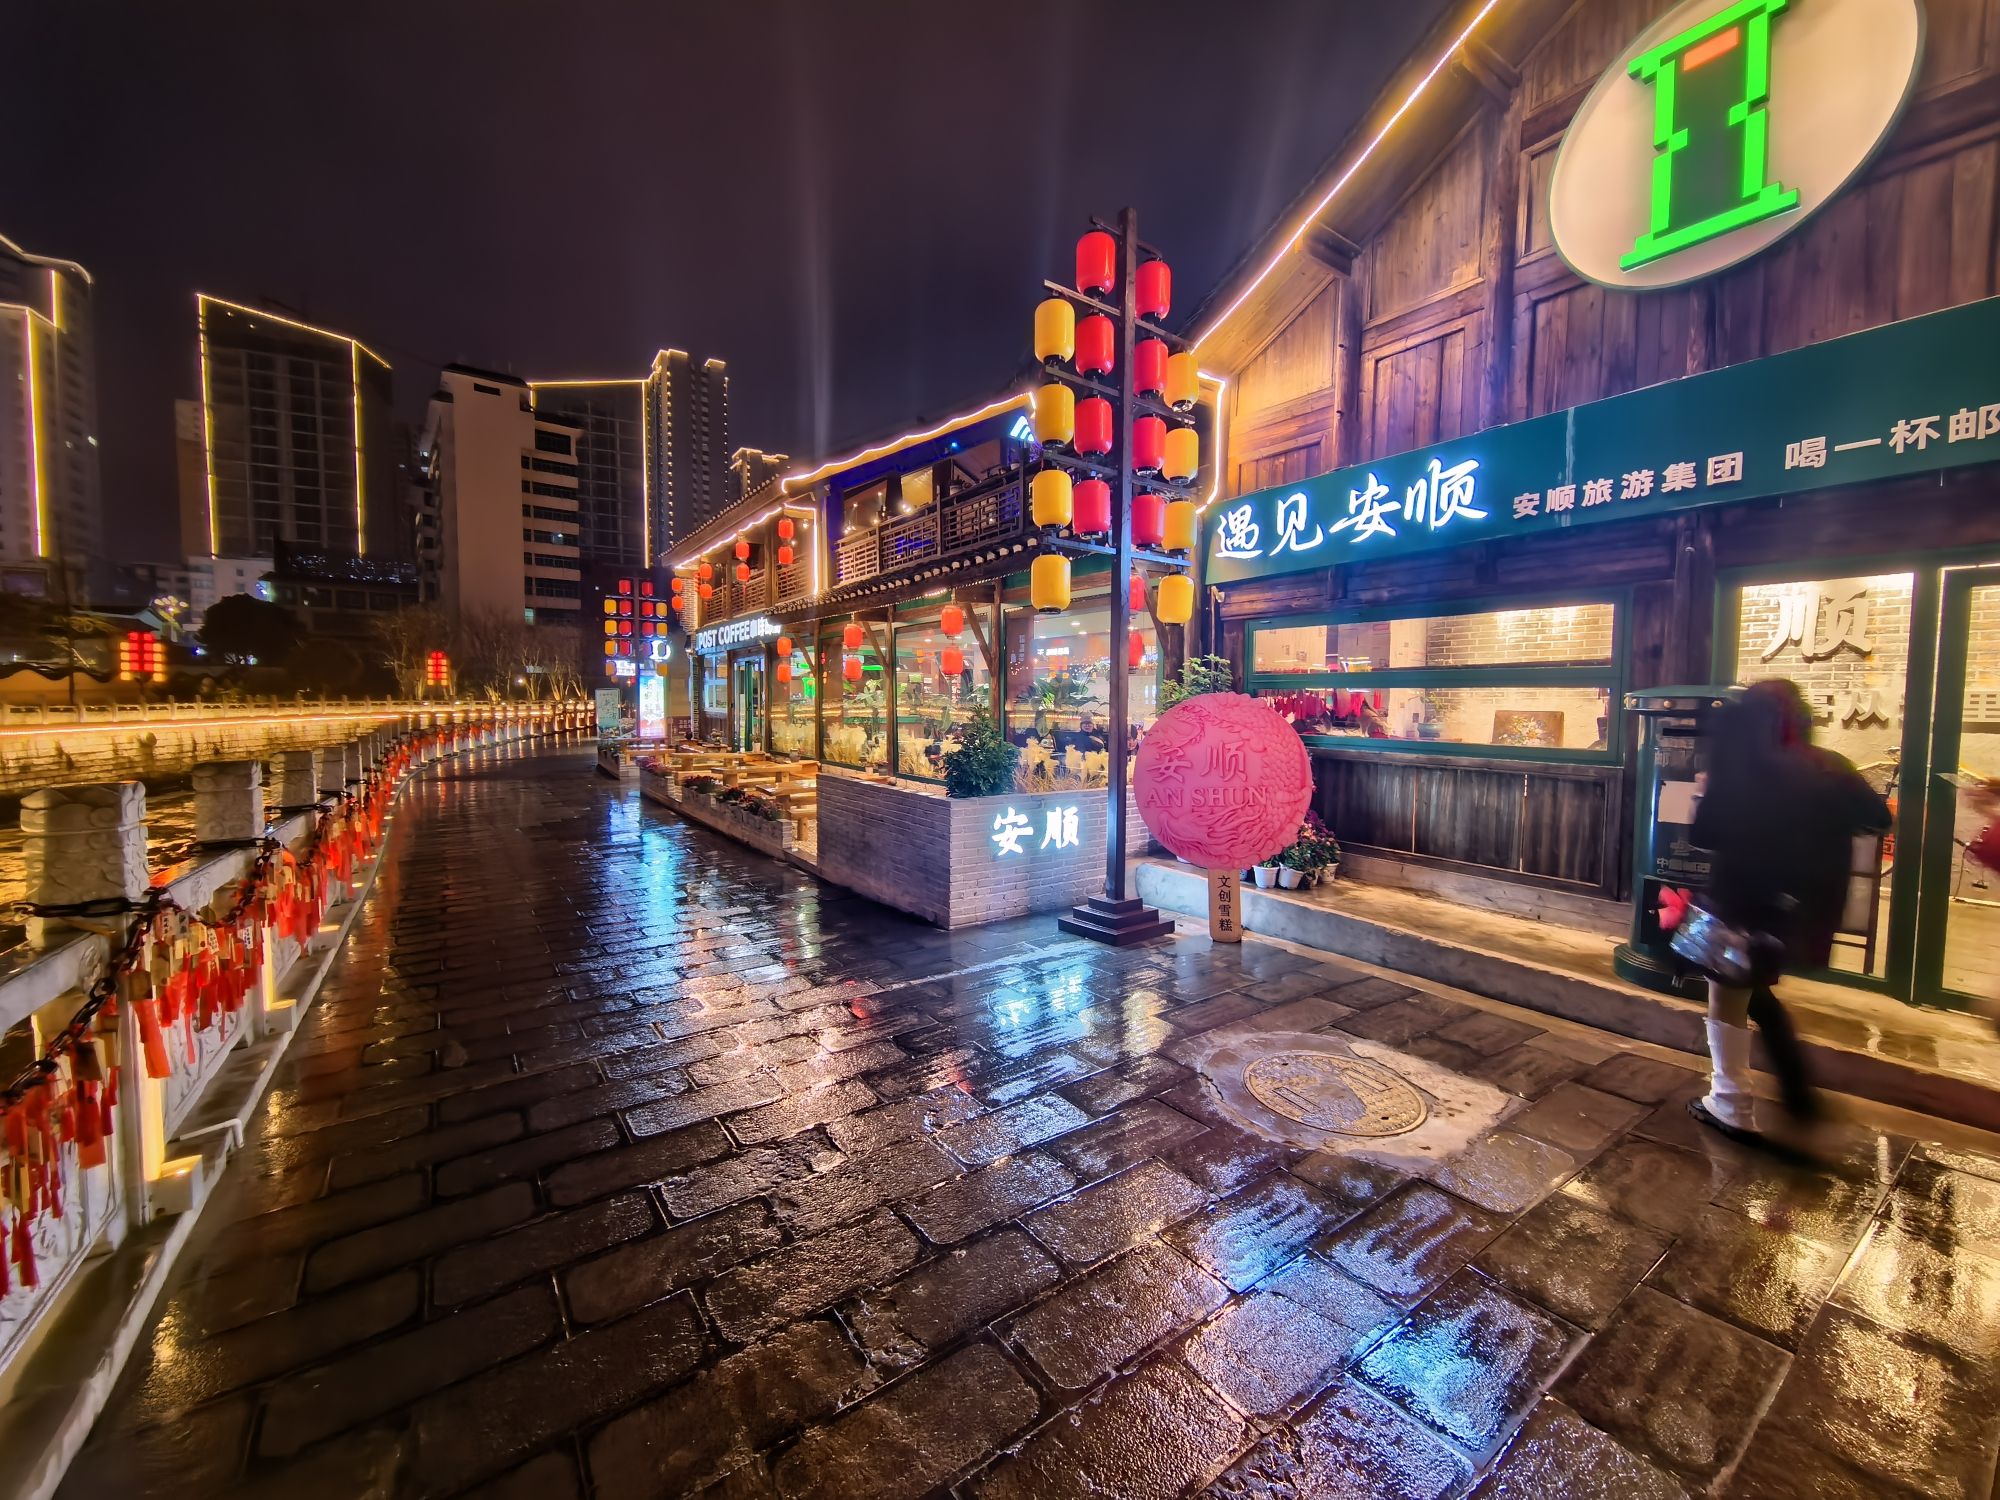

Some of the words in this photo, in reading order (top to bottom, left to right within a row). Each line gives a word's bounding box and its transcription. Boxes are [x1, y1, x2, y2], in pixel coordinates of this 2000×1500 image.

[1785, 402, 2000, 471] 喝一杯邮
[1216, 457, 1489, 558] 遇见安顺
[1513, 451, 1744, 520] 安顺旅游集团
[718, 620, 750, 646] COFFEE
[1761, 588, 1873, 664] 顺
[1146, 740, 1248, 784] 安顺
[1144, 787, 1185, 808] AN
[1191, 786, 1268, 808] SHUN
[991, 806, 1080, 857] 安顺
[1217, 874, 1233, 932] 文创雪糕
